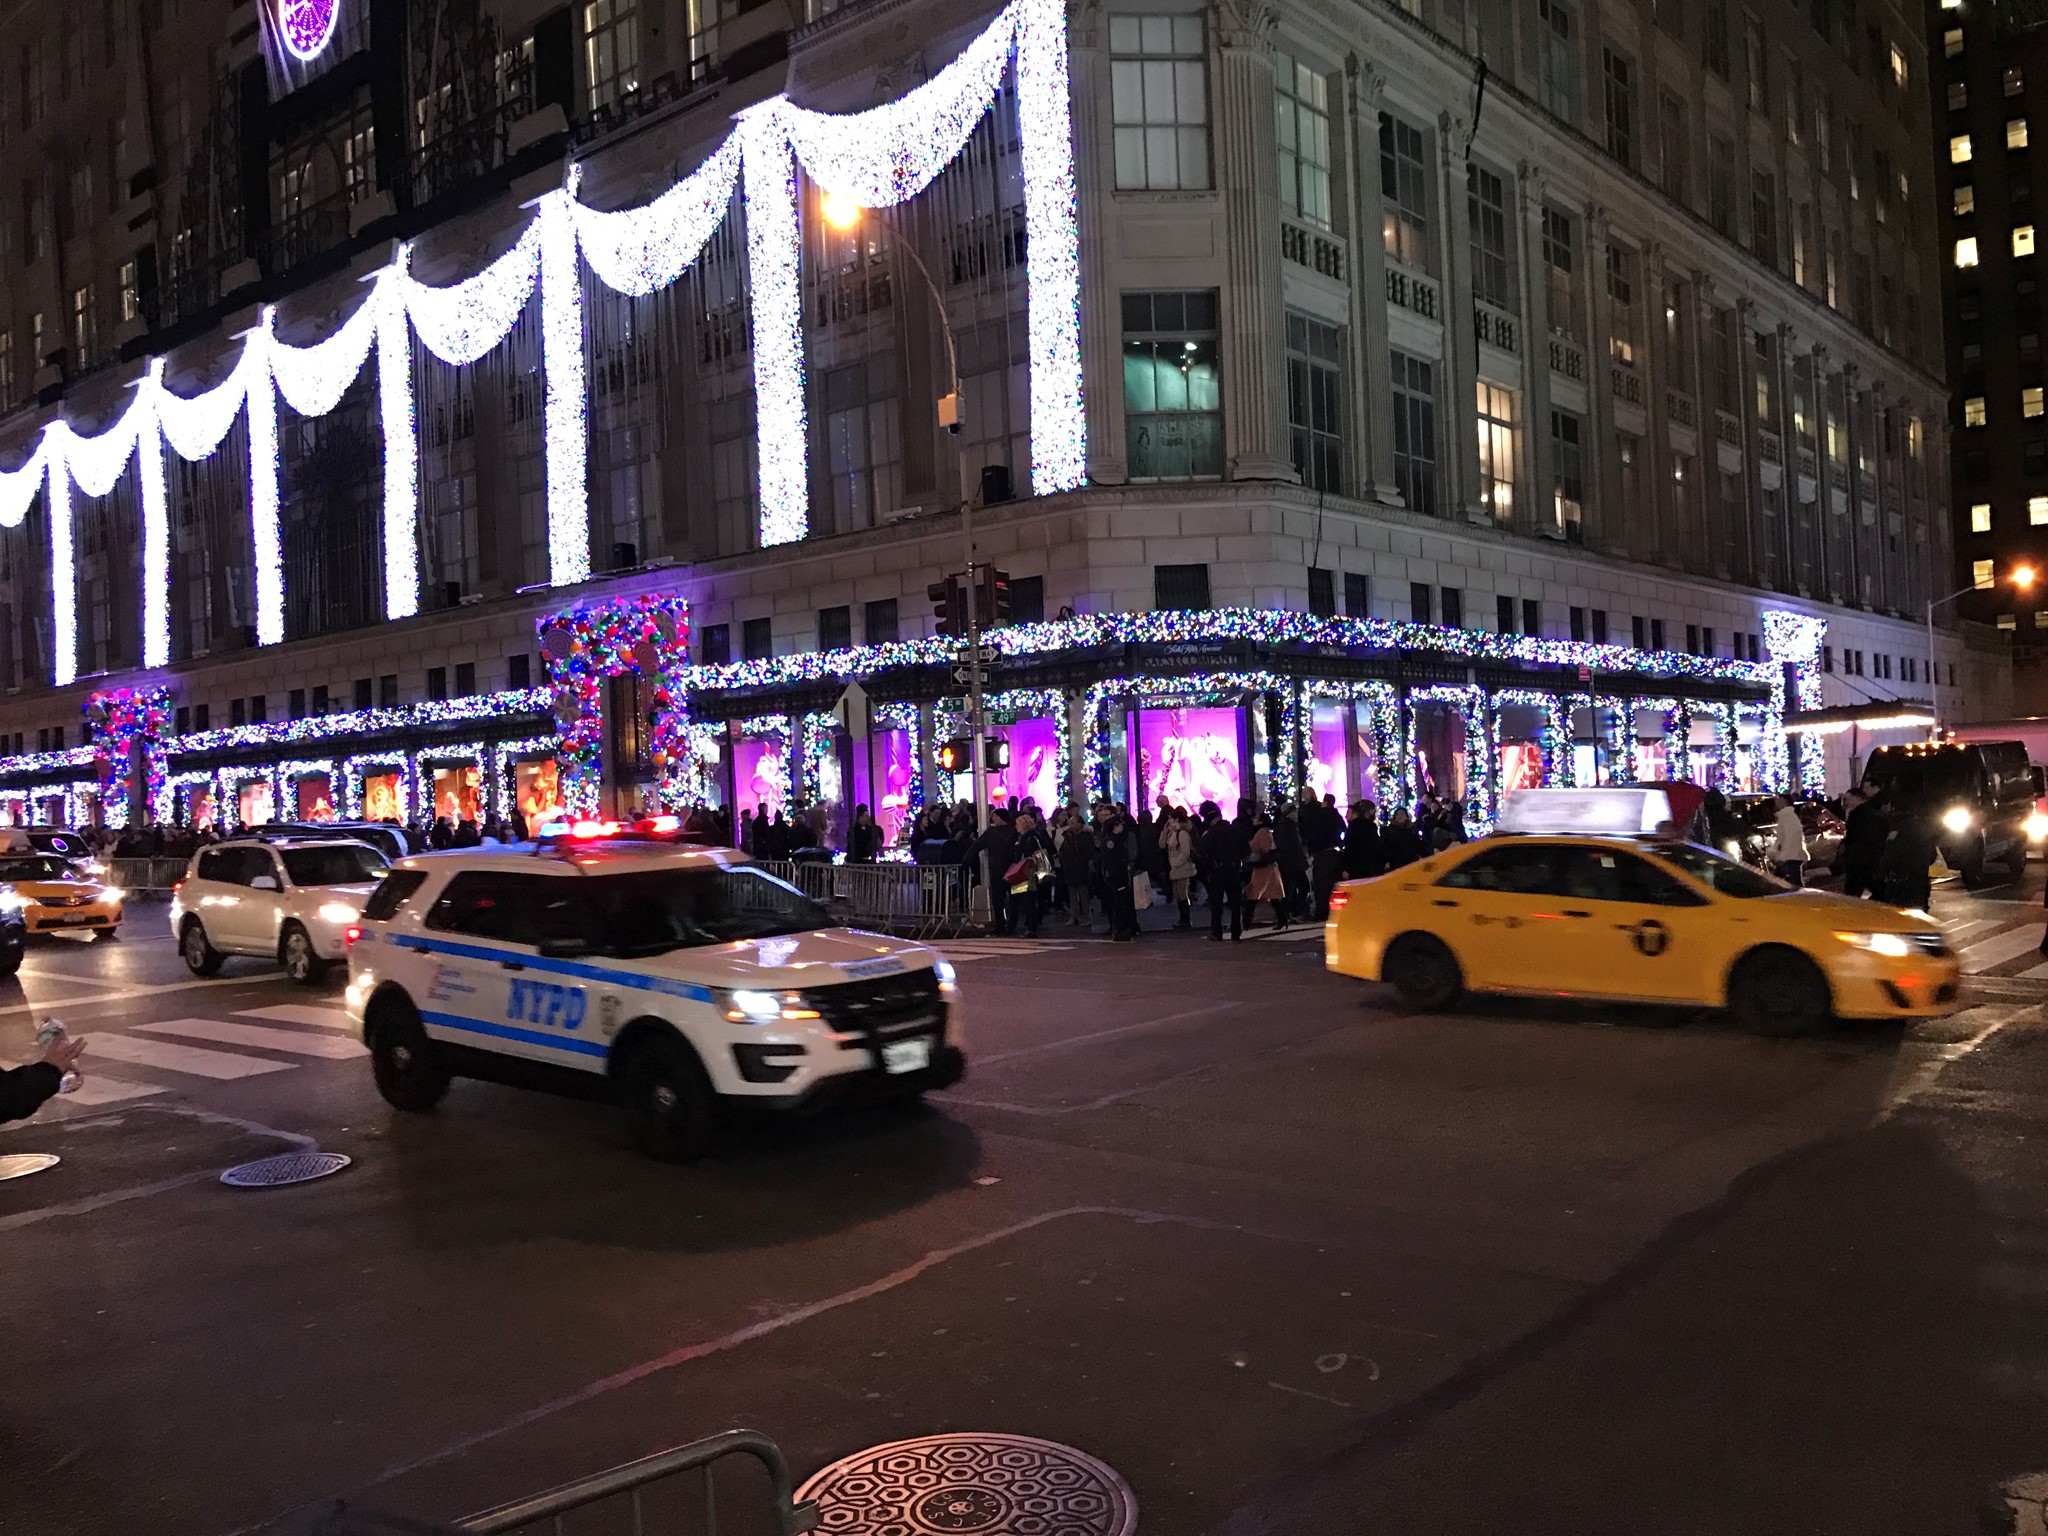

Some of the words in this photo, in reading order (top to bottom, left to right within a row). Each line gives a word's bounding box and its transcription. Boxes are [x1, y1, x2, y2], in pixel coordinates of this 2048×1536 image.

[947, 700, 954, 711] 5
[990, 713, 996, 725] E
[998, 713, 1009, 725] 49
[506, 978, 587, 1030] NYPD
